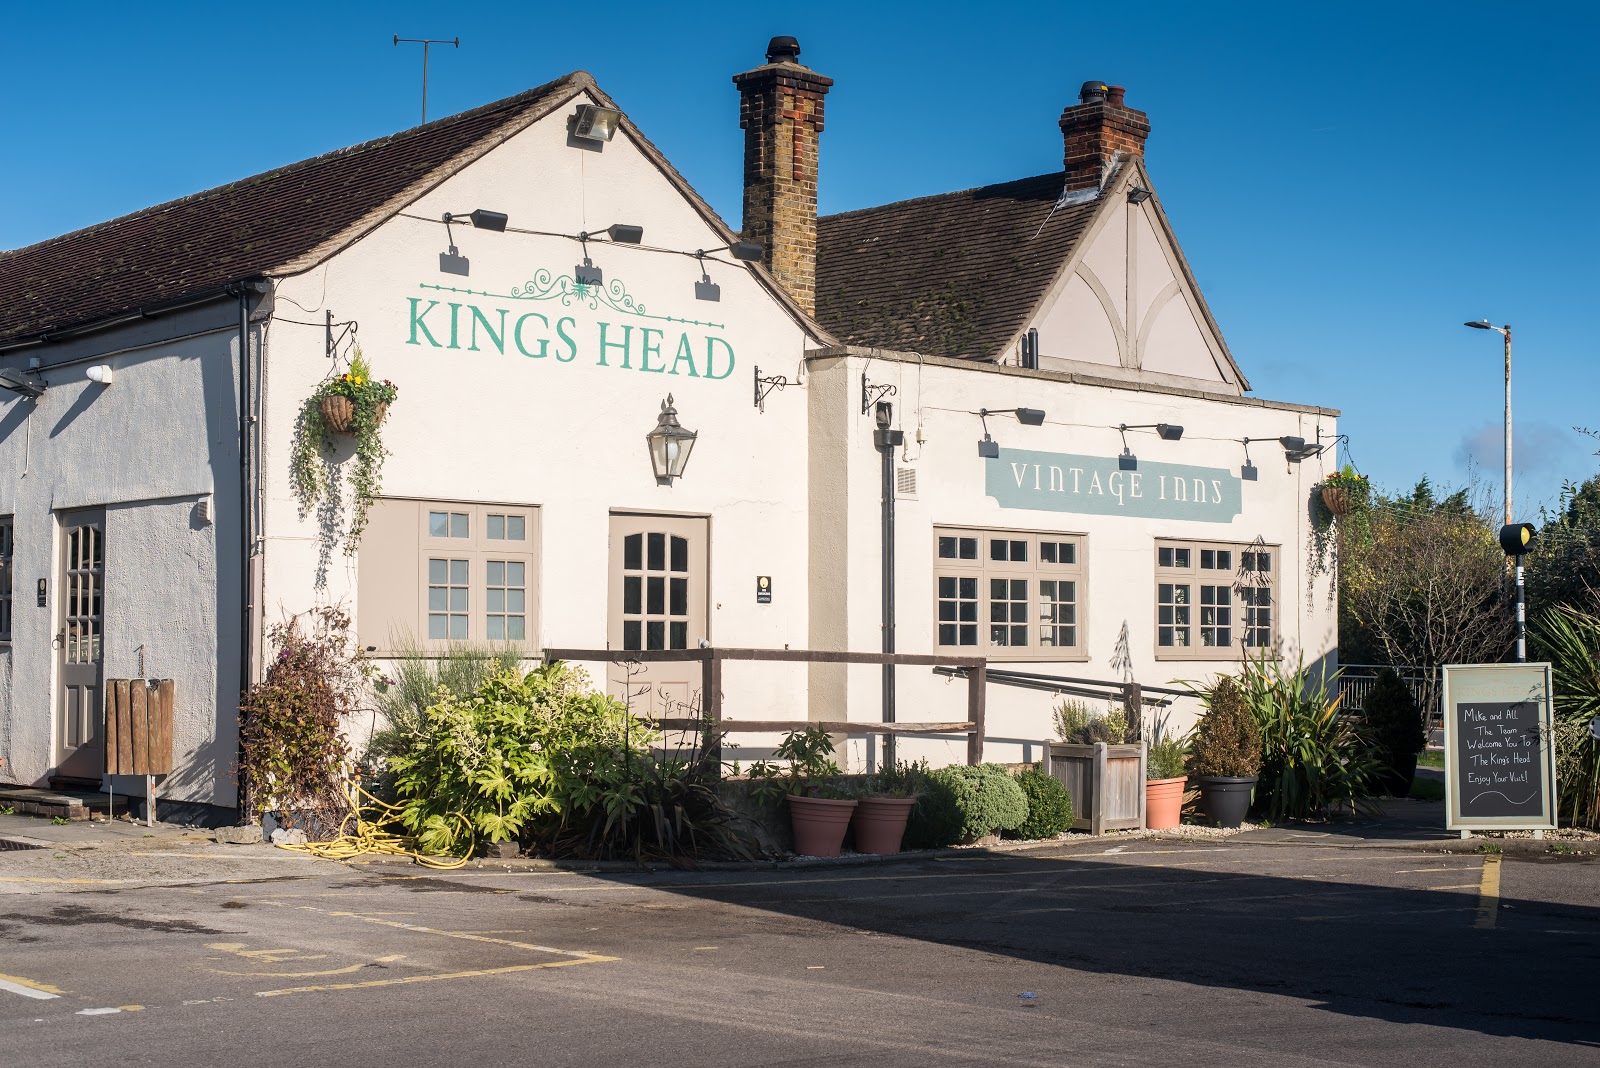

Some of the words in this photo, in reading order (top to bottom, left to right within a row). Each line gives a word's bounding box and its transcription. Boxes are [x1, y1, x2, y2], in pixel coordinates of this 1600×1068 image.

[405, 296, 578, 363] KINGS
[595, 321, 736, 380] HEAD
[1010, 462, 1143, 506] VINTAGE
[1158, 475, 1223, 505] INNS
[1457, 687, 1497, 697] KINGS
[1501, 686, 1536, 697] HEA
[1464, 708, 1487, 722] Mike
[1489, 711, 1502, 721] and
[1506, 709, 1518, 720] All
[1474, 725, 1493, 736] The
[1497, 724, 1517, 735] Team
[1466, 739, 1502, 750] Welcome
[1505, 736, 1518, 748] You
[1520, 734, 1531, 747] To
[1470, 754, 1489, 767] The
[1490, 752, 1510, 766] King's
[1513, 751, 1531, 764] Head
[1468, 772, 1491, 786] Enjoy
[1492, 771, 1508, 784] Your
